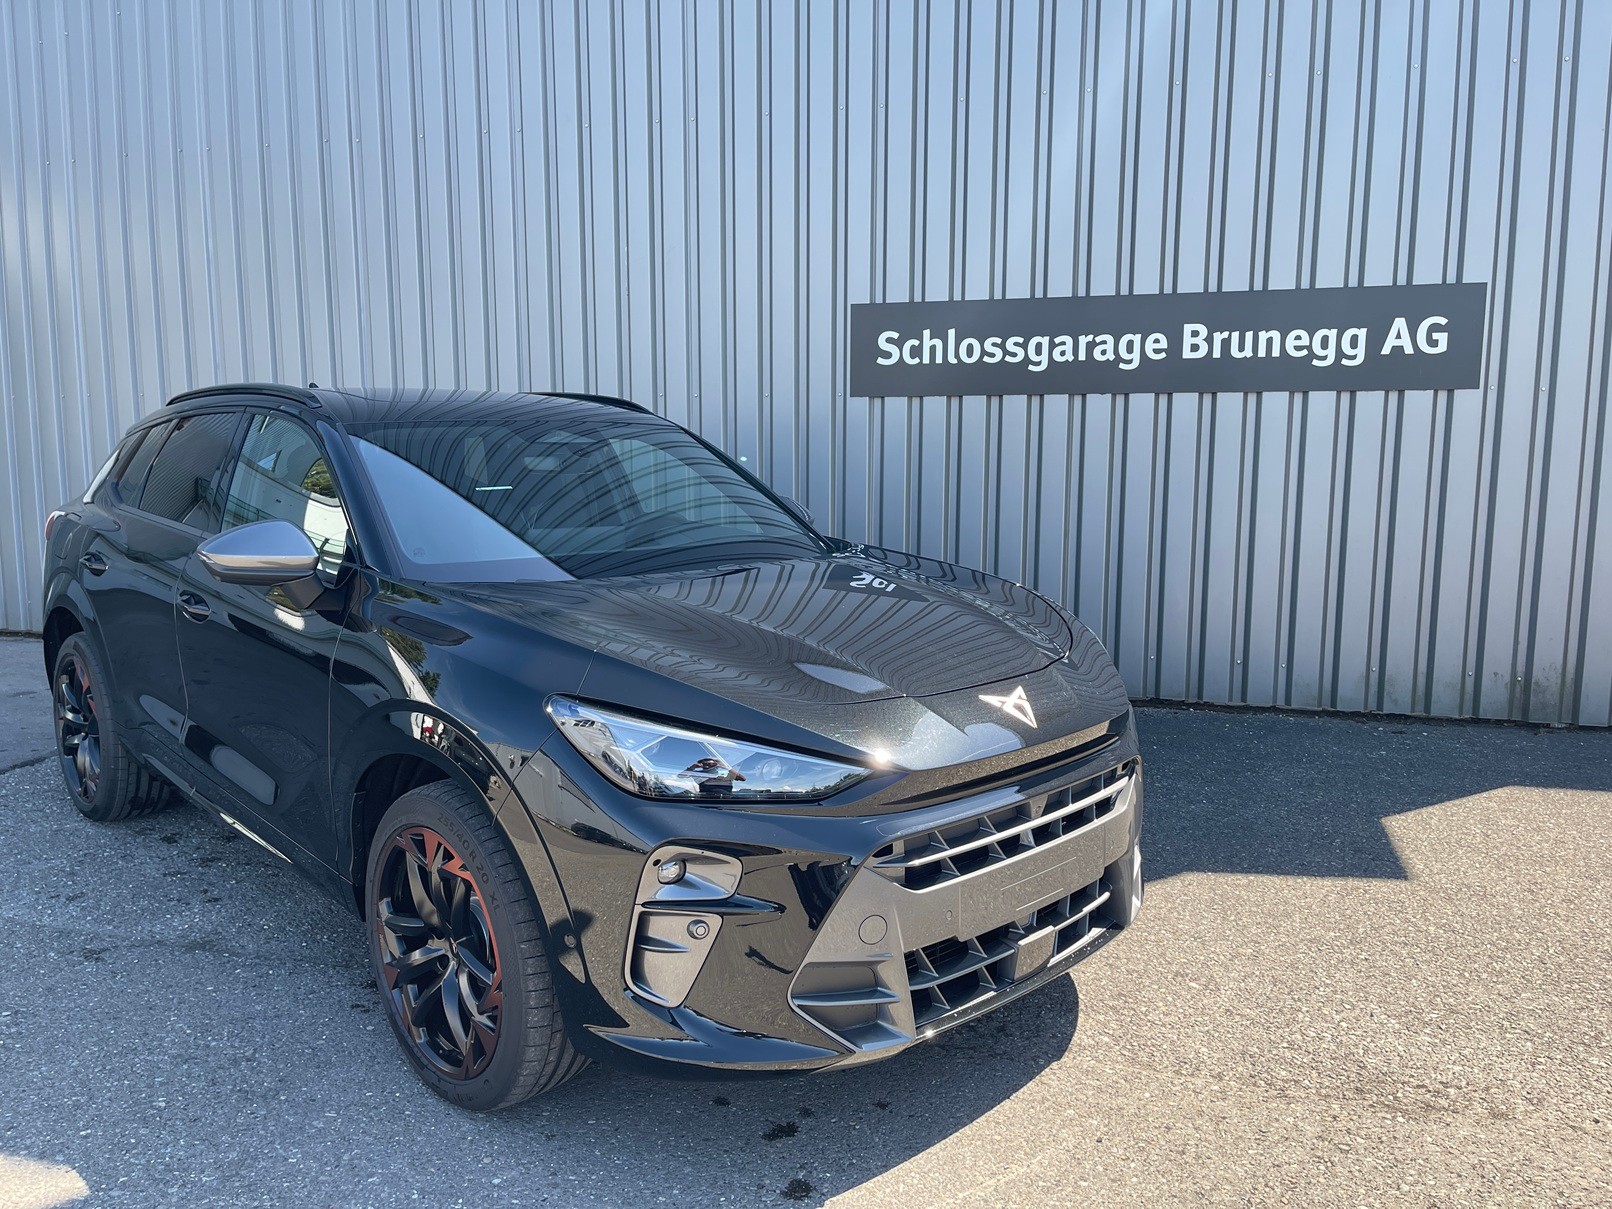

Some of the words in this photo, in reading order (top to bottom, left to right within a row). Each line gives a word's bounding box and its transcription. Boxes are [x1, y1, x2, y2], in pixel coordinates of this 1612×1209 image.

[876, 328, 1168, 372] Schlossgarage
[1182, 324, 1368, 367] Brunegg
[1380, 316, 1449, 355] AG
[476, 862, 490, 885] 20
[488, 890, 500, 915] XL
